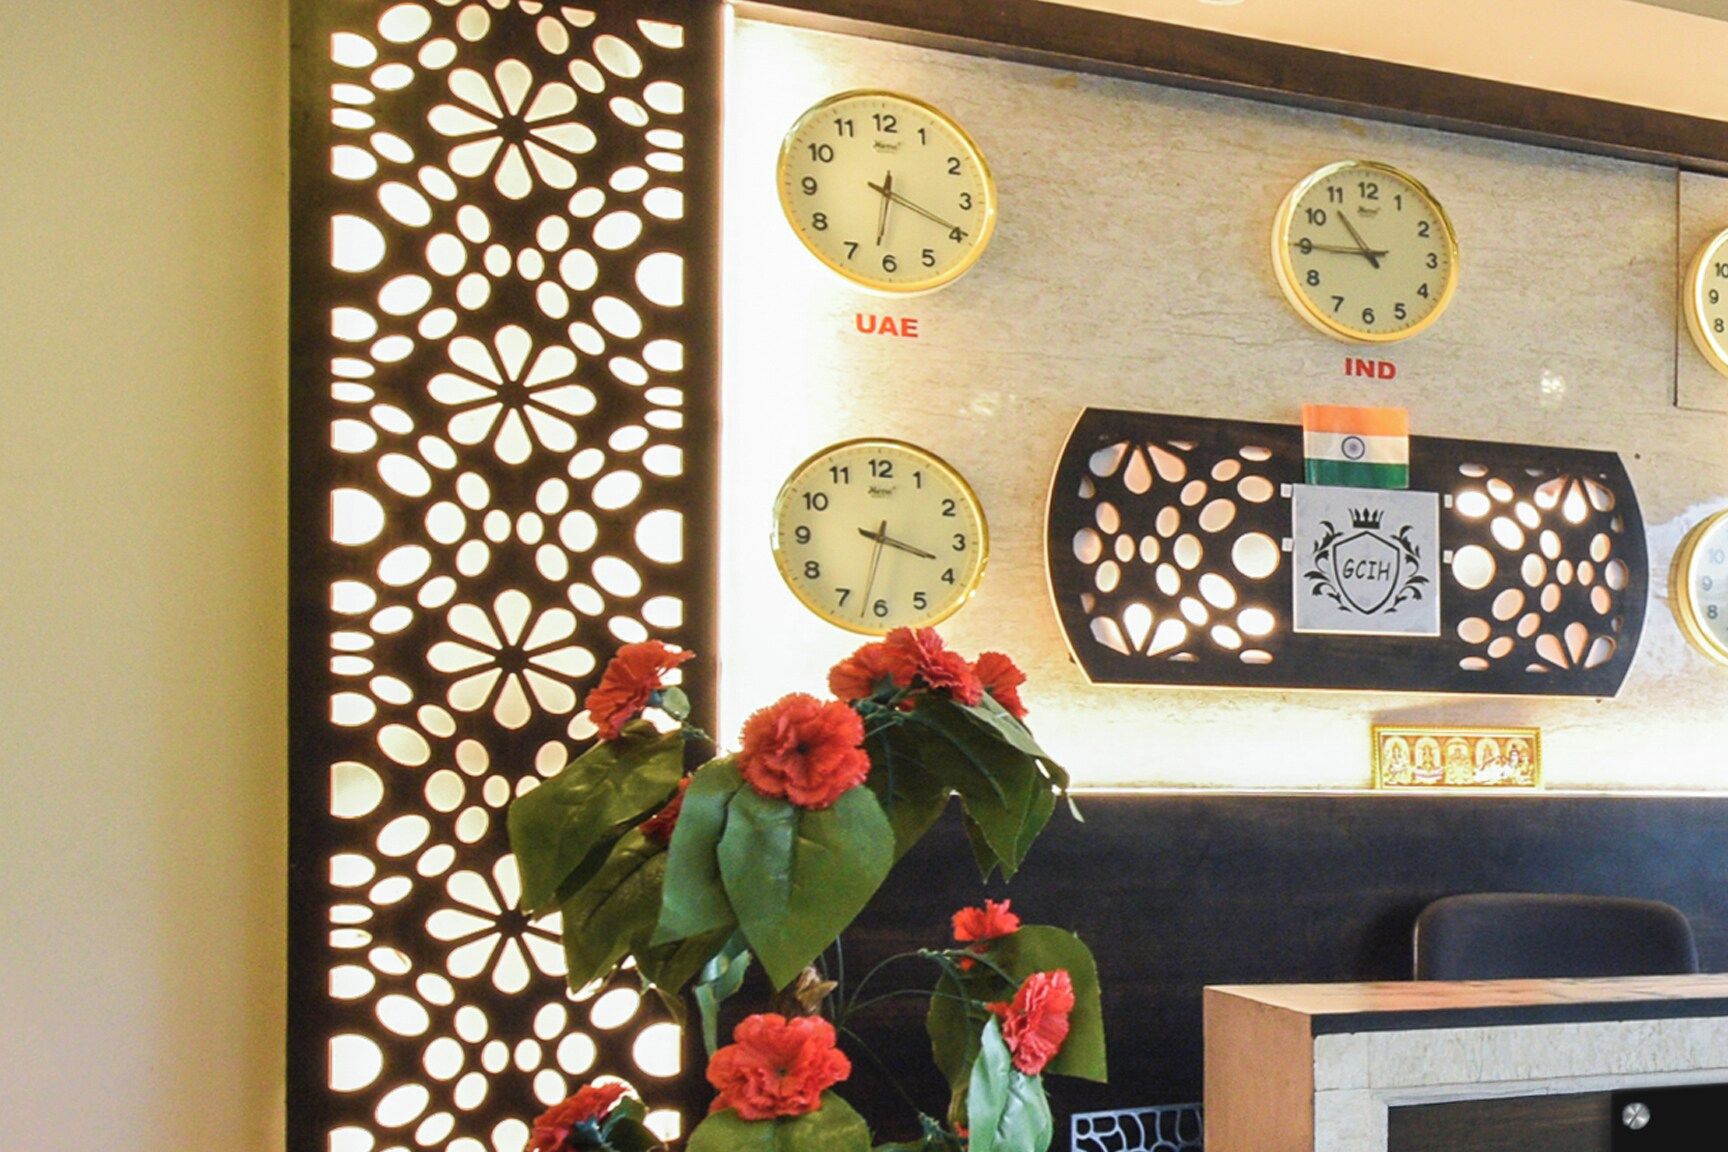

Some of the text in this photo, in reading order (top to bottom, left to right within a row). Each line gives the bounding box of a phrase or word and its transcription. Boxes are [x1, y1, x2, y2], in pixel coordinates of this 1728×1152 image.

[834, 119, 854, 137] 11
[873, 114, 897, 133] 12
[918, 128, 926, 145] 1
[809, 144, 834, 163] 10
[947, 157, 961, 175] 2
[802, 176, 817, 196] 9
[1328, 186, 1343, 203] 11
[1358, 182, 1379, 200] 12
[959, 193, 972, 210] 3
[1394, 195, 1402, 210] 1
[812, 213, 828, 231] 8
[1306, 208, 1326, 226] 10
[1418, 221, 1429, 238] 2
[844, 242, 859, 259] 7
[1299, 238, 1312, 254] 9
[882, 255, 897, 273] 6
[922, 249, 936, 266] 5
[1426, 253, 1438, 269] 3
[1307, 270, 1320, 286] 8
[1418, 283, 1429, 298] 4
[1708, 290, 1719, 304] 9
[1331, 296, 1344, 312] 7
[1395, 303, 1406, 320] 5
[1362, 308, 1375, 324] 6
[856, 313, 918, 337] UAE
[1714, 318, 1724, 332] 8
[1345, 358, 1396, 379] IND
[829, 466, 849, 484] 11
[868, 459, 893, 478] 12
[913, 471, 921, 488] 1
[802, 492, 828, 511] 10
[941, 499, 956, 517] 2
[795, 526, 811, 544] 9
[952, 534, 966, 551] 3
[804, 561, 820, 579] 8
[941, 568, 955, 584] 4
[1342, 558, 1391, 581] GCIH
[1702, 576, 1713, 590] 9
[835, 588, 850, 607] 7
[913, 592, 927, 610] 5
[873, 600, 888, 617] 6
[1707, 605, 1718, 619] 8
